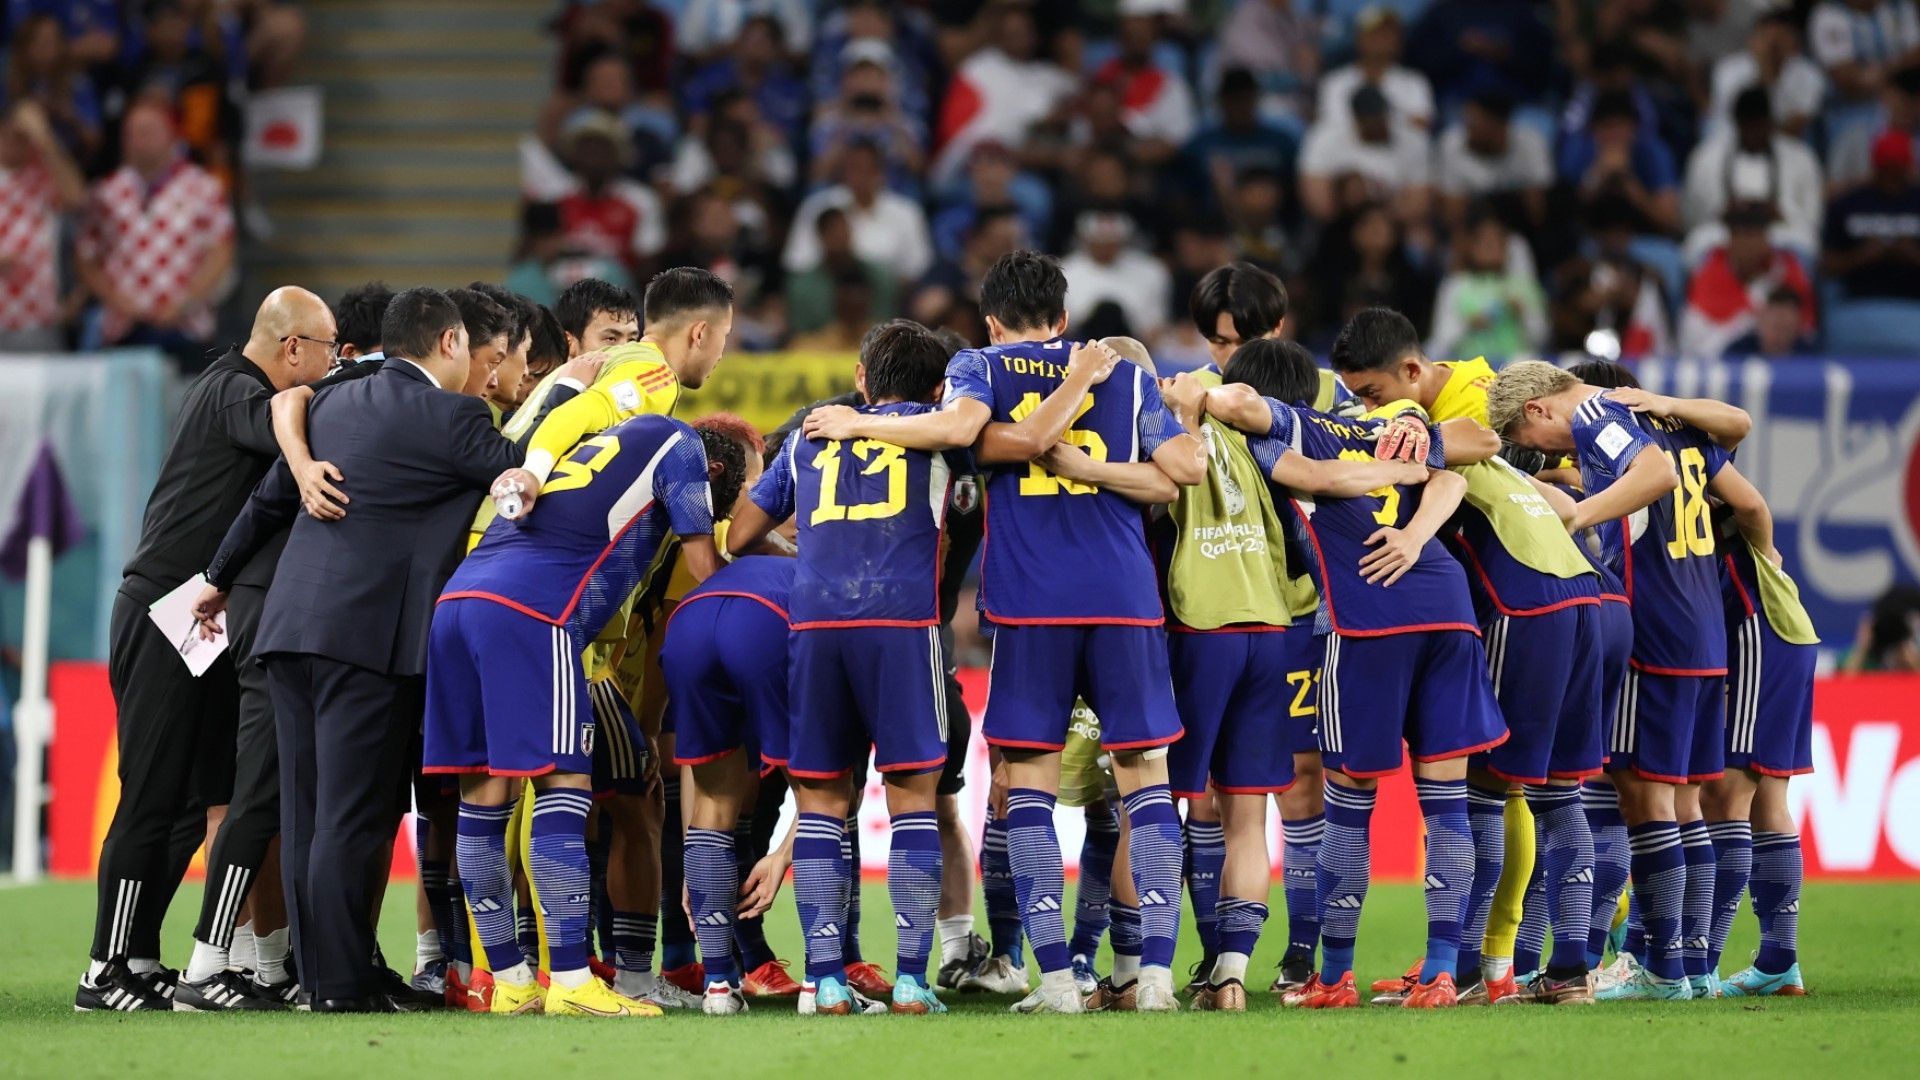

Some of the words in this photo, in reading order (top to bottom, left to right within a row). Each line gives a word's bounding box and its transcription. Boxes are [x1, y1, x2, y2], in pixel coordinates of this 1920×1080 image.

[1001, 355, 1070, 379] TOMIY
[810, 438, 907, 527] 13
[1664, 447, 1715, 559] 18
[1193, 525, 1223, 540] FIFA
[1286, 870, 1316, 878] JAP
